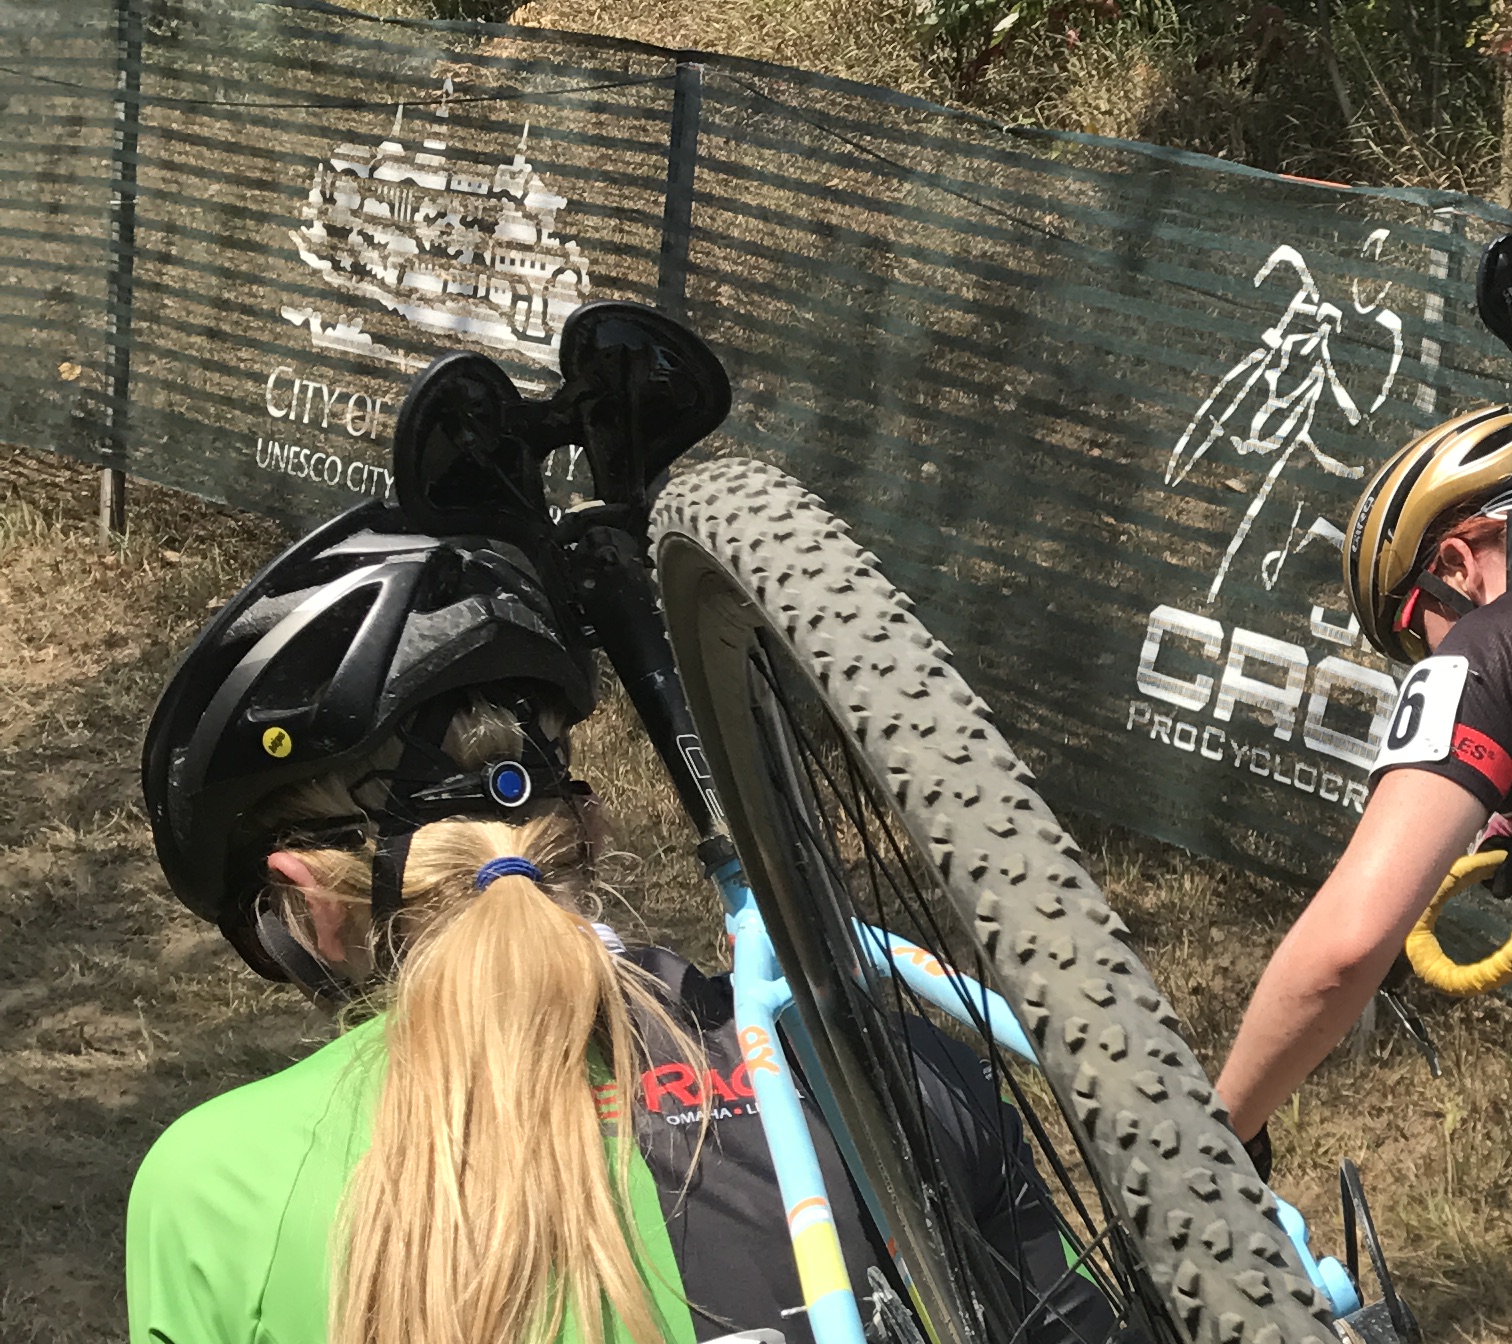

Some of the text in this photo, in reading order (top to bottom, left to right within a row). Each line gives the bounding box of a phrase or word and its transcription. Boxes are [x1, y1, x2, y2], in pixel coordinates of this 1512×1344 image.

[265, 366, 340, 429] CITY
[255, 437, 395, 499] UNESCO CITY
[1137, 604, 1400, 771] CRO
[1126, 700, 1369, 814] PROCYCLOCR
[641, 1062, 757, 1113] RAC
